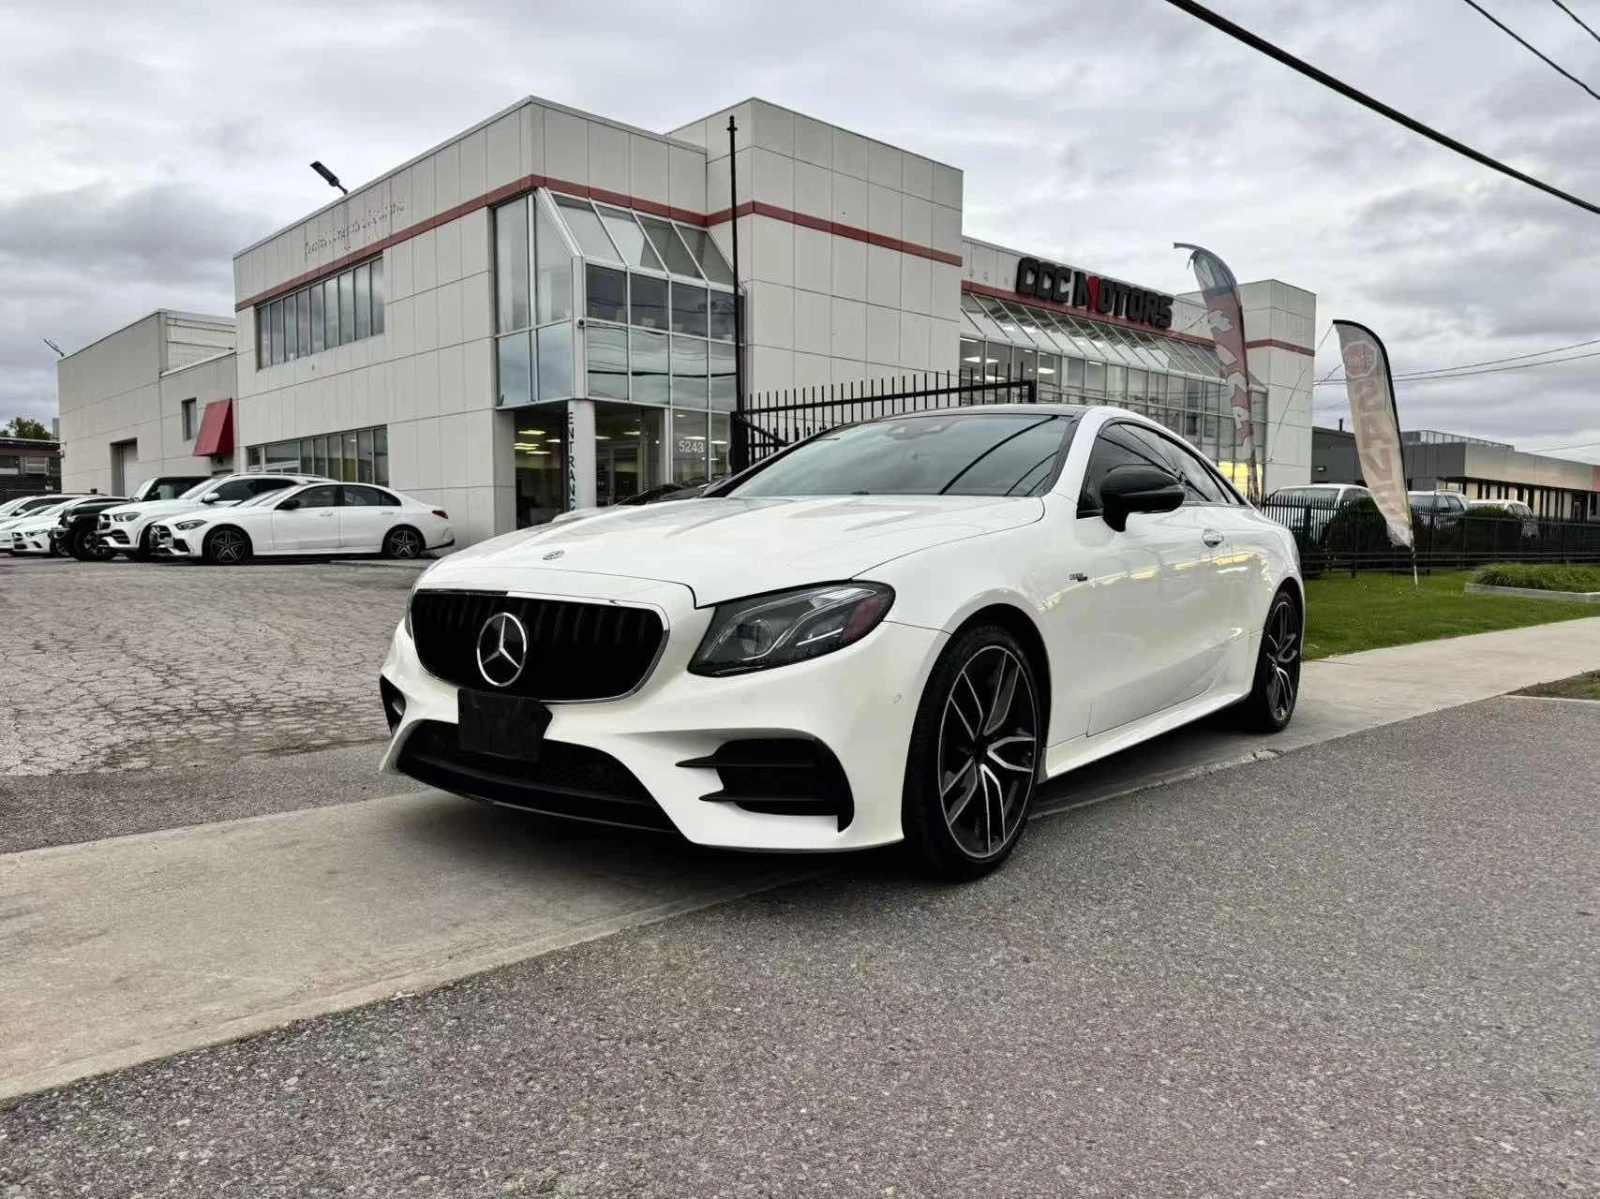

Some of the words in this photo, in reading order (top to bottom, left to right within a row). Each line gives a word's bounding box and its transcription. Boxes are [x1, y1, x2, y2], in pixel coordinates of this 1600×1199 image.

[1072, 271, 1175, 330] MOTORS
[567, 411, 576, 511] ENTRANC
[678, 440, 704, 453] 5243
